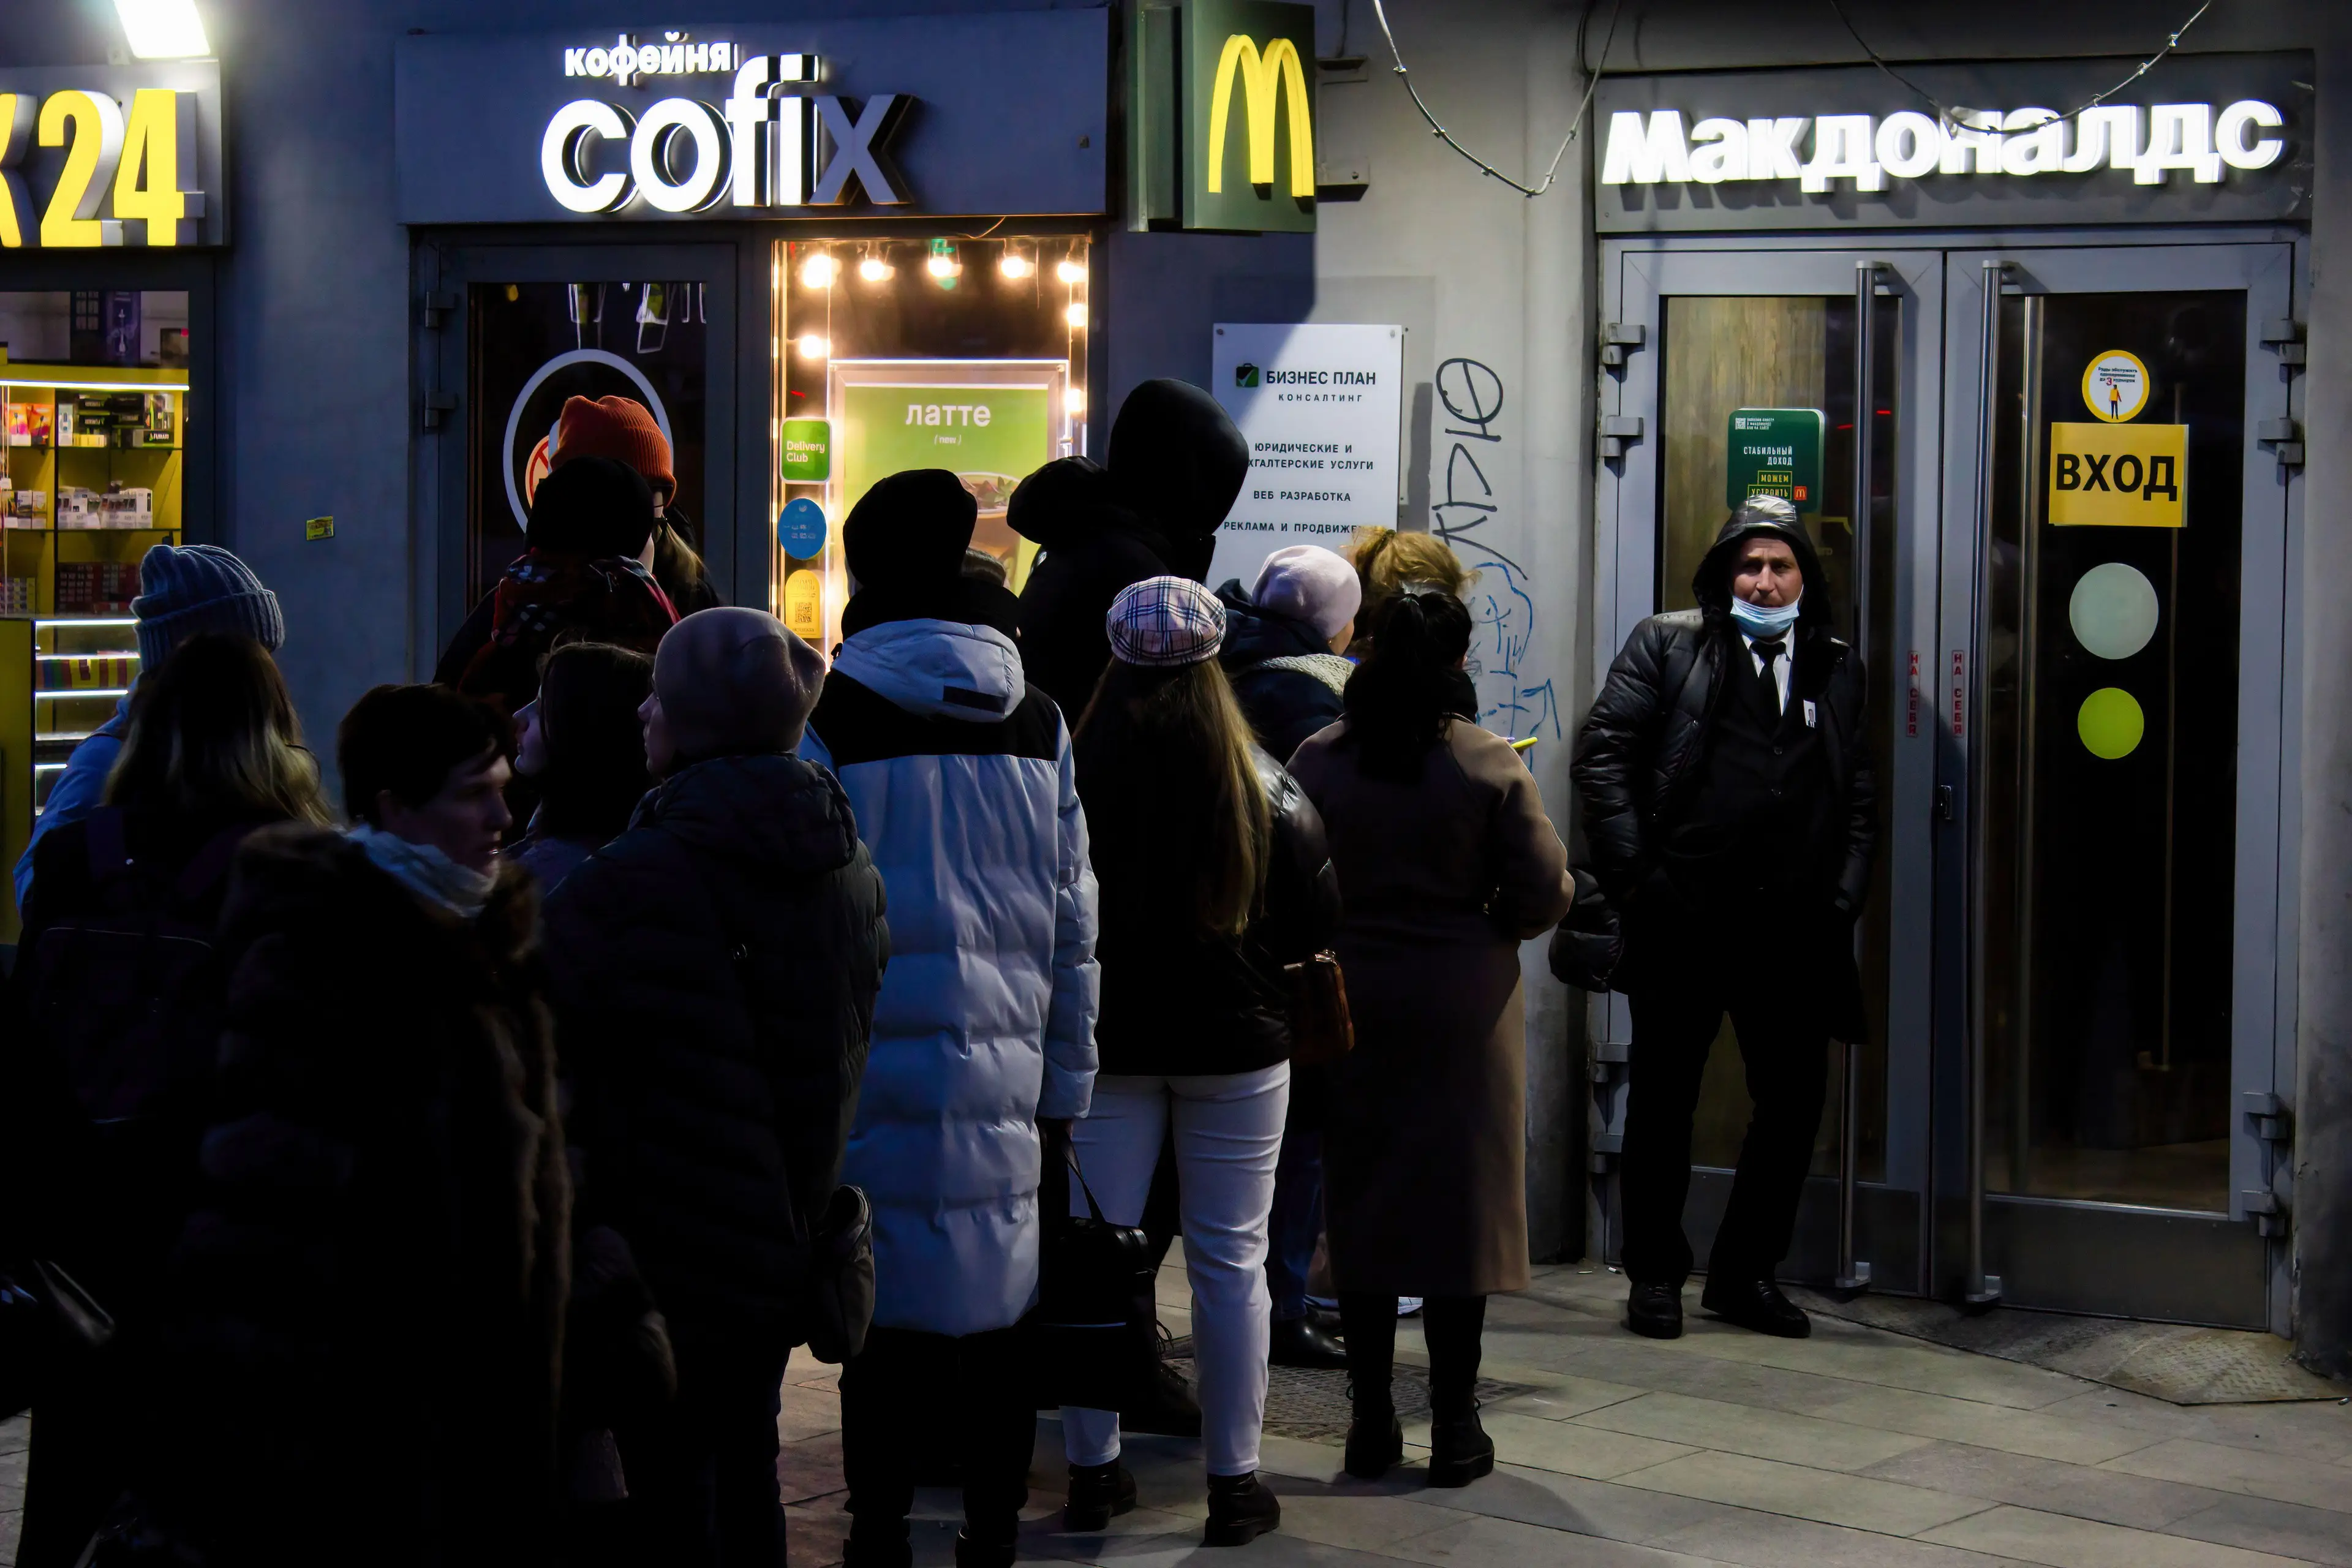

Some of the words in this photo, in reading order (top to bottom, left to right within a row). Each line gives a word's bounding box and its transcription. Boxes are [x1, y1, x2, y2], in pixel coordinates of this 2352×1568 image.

[565, 32, 736, 86] кофейня
[541, 53, 905, 213] cofix
[1601, 99, 2284, 194] Макдоналдс
[1266, 370, 1328, 384] БИЗНЕС
[1333, 372, 1376, 385] ПЛАН
[905, 403, 991, 427] латте
[786, 440, 826, 453] Delivery
[1254, 443, 1339, 454] ЮРИДИЧЕСКИЕ
[1345, 444, 1352, 453] И
[1743, 445, 1793, 455] СТАБИЛЬНЫЙ
[786, 452, 809, 462] Club
[1766, 456, 1793, 466] ДОХОД
[1248, 459, 1324, 469] ХГАЛТЕРСКИЕ
[1330, 460, 1374, 470] УСЛУГИ
[1761, 474, 1789, 483] МОЖЕМ
[2056, 453, 2178, 502] ВХОД
[1253, 490, 1274, 499] ВЕБ
[1280, 491, 1351, 502] РАЗРАБОТКА
[1224, 521, 1275, 532] РЕКЛАМА
[1294, 523, 1357, 534] ПРОДВИЖЕ
